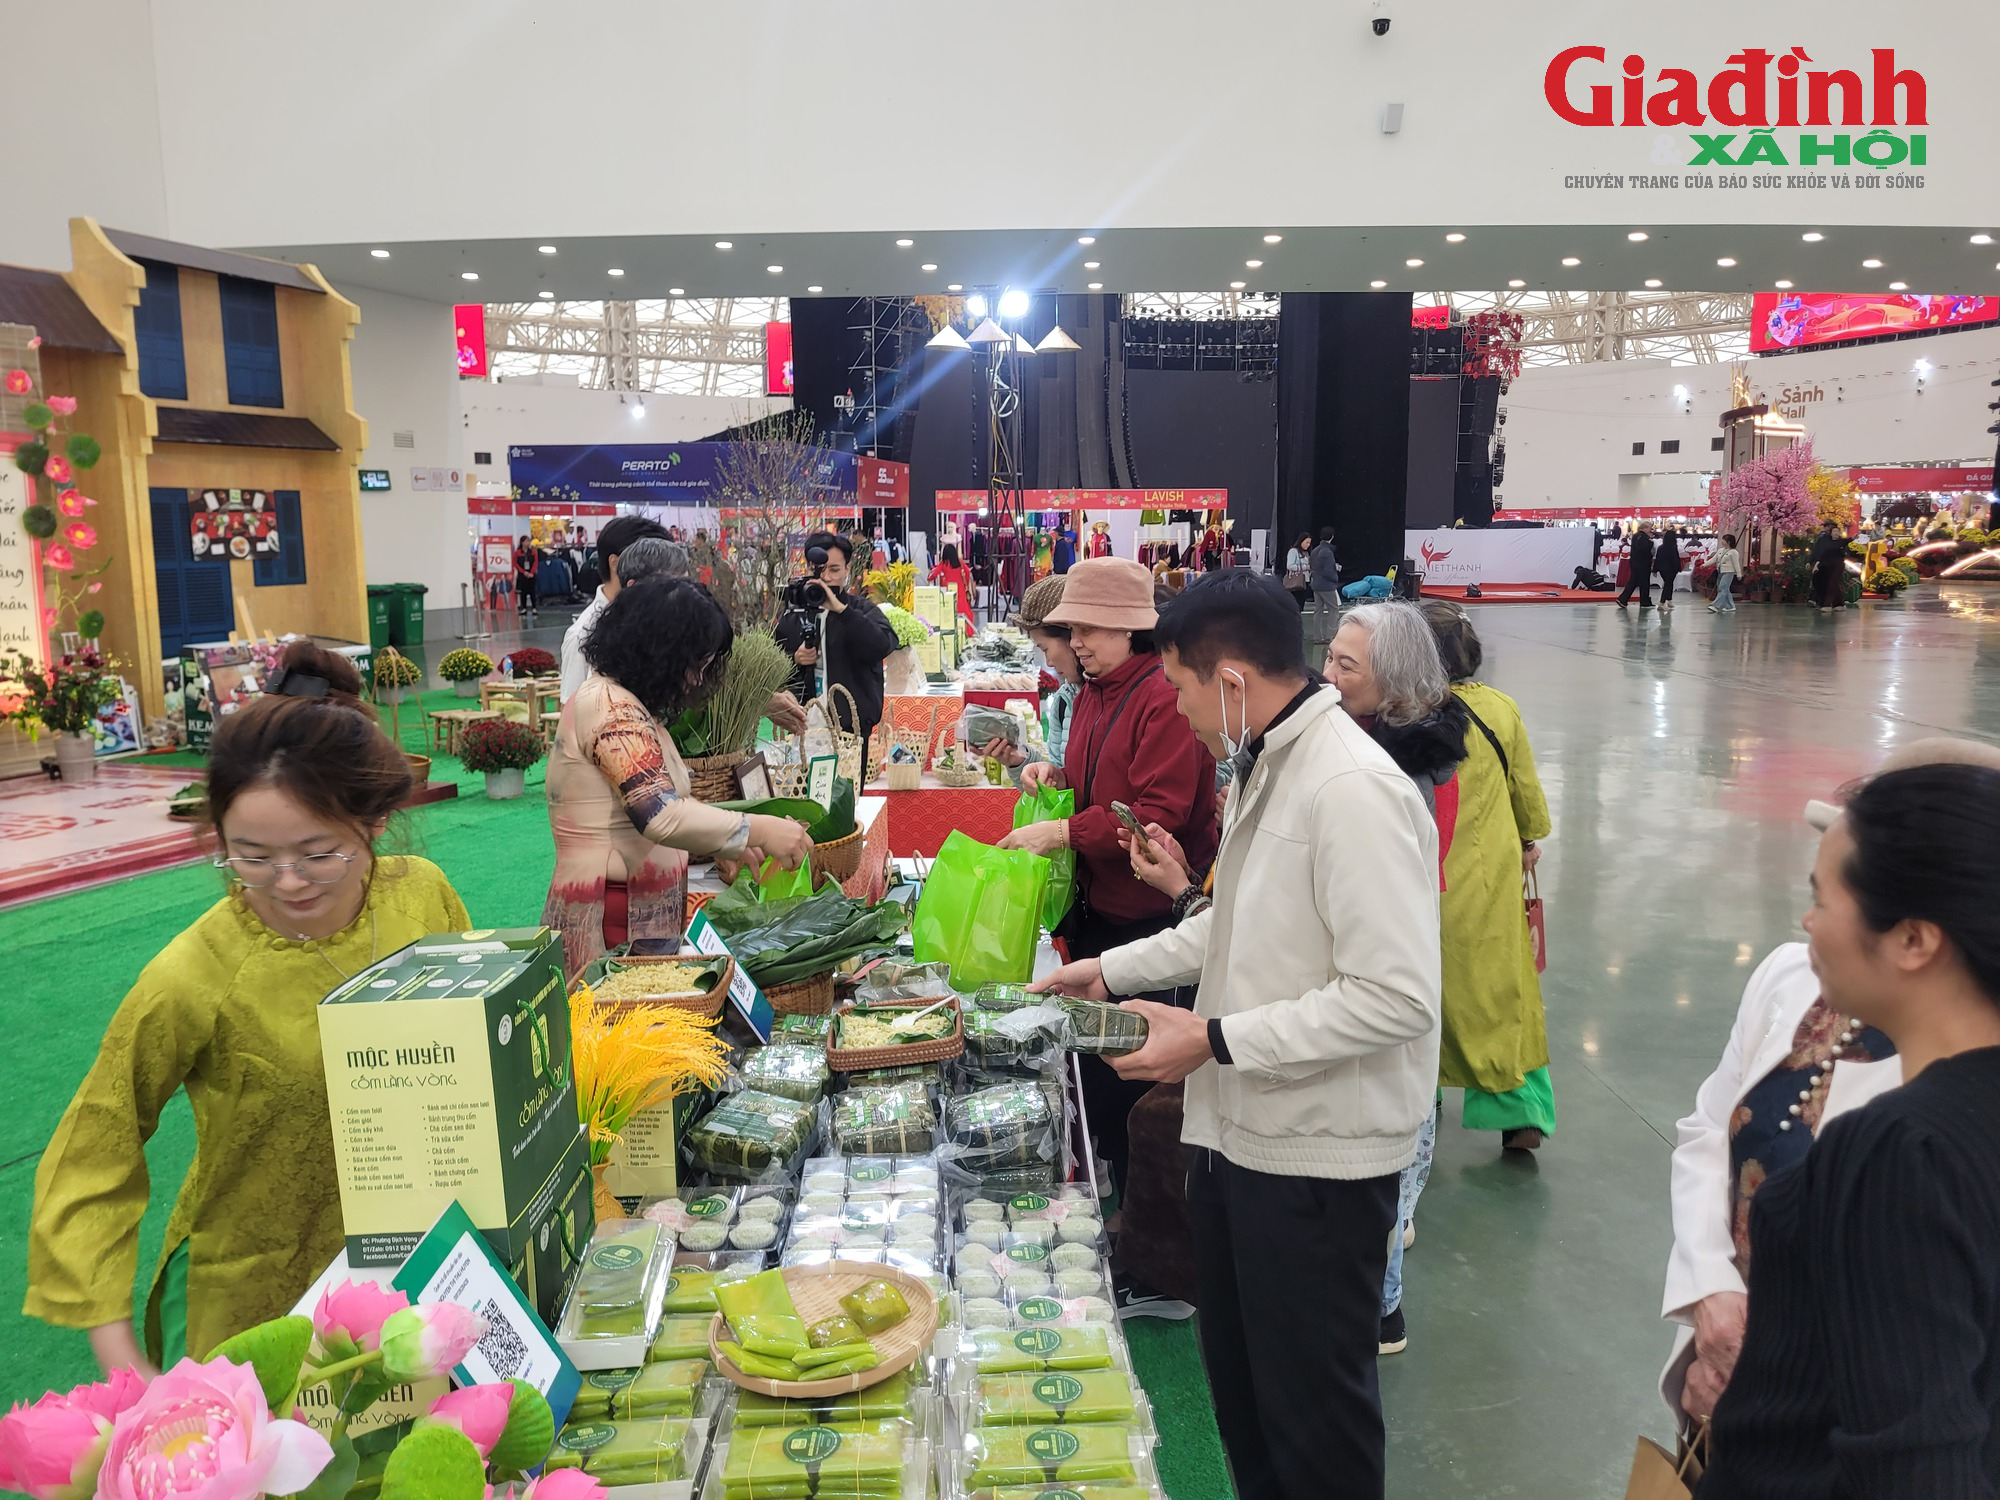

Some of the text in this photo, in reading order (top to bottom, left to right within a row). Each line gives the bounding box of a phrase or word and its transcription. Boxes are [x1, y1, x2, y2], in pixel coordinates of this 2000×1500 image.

[1778, 385, 1824, 404] Sảnh
[621, 460, 670, 471] PERATO
[1144, 491, 1184, 502] LAVISH
[0, 531, 17, 548] ai
[0, 596, 28, 610] uân
[0, 627, 31, 645] ạnh
[188, 719, 215, 733] KEM
[346, 1040, 456, 1070] MỘC HUYỀN
[350, 1072, 458, 1090] CỐM LÀNG VÒNG
[307, 1414, 333, 1429] ỐM
